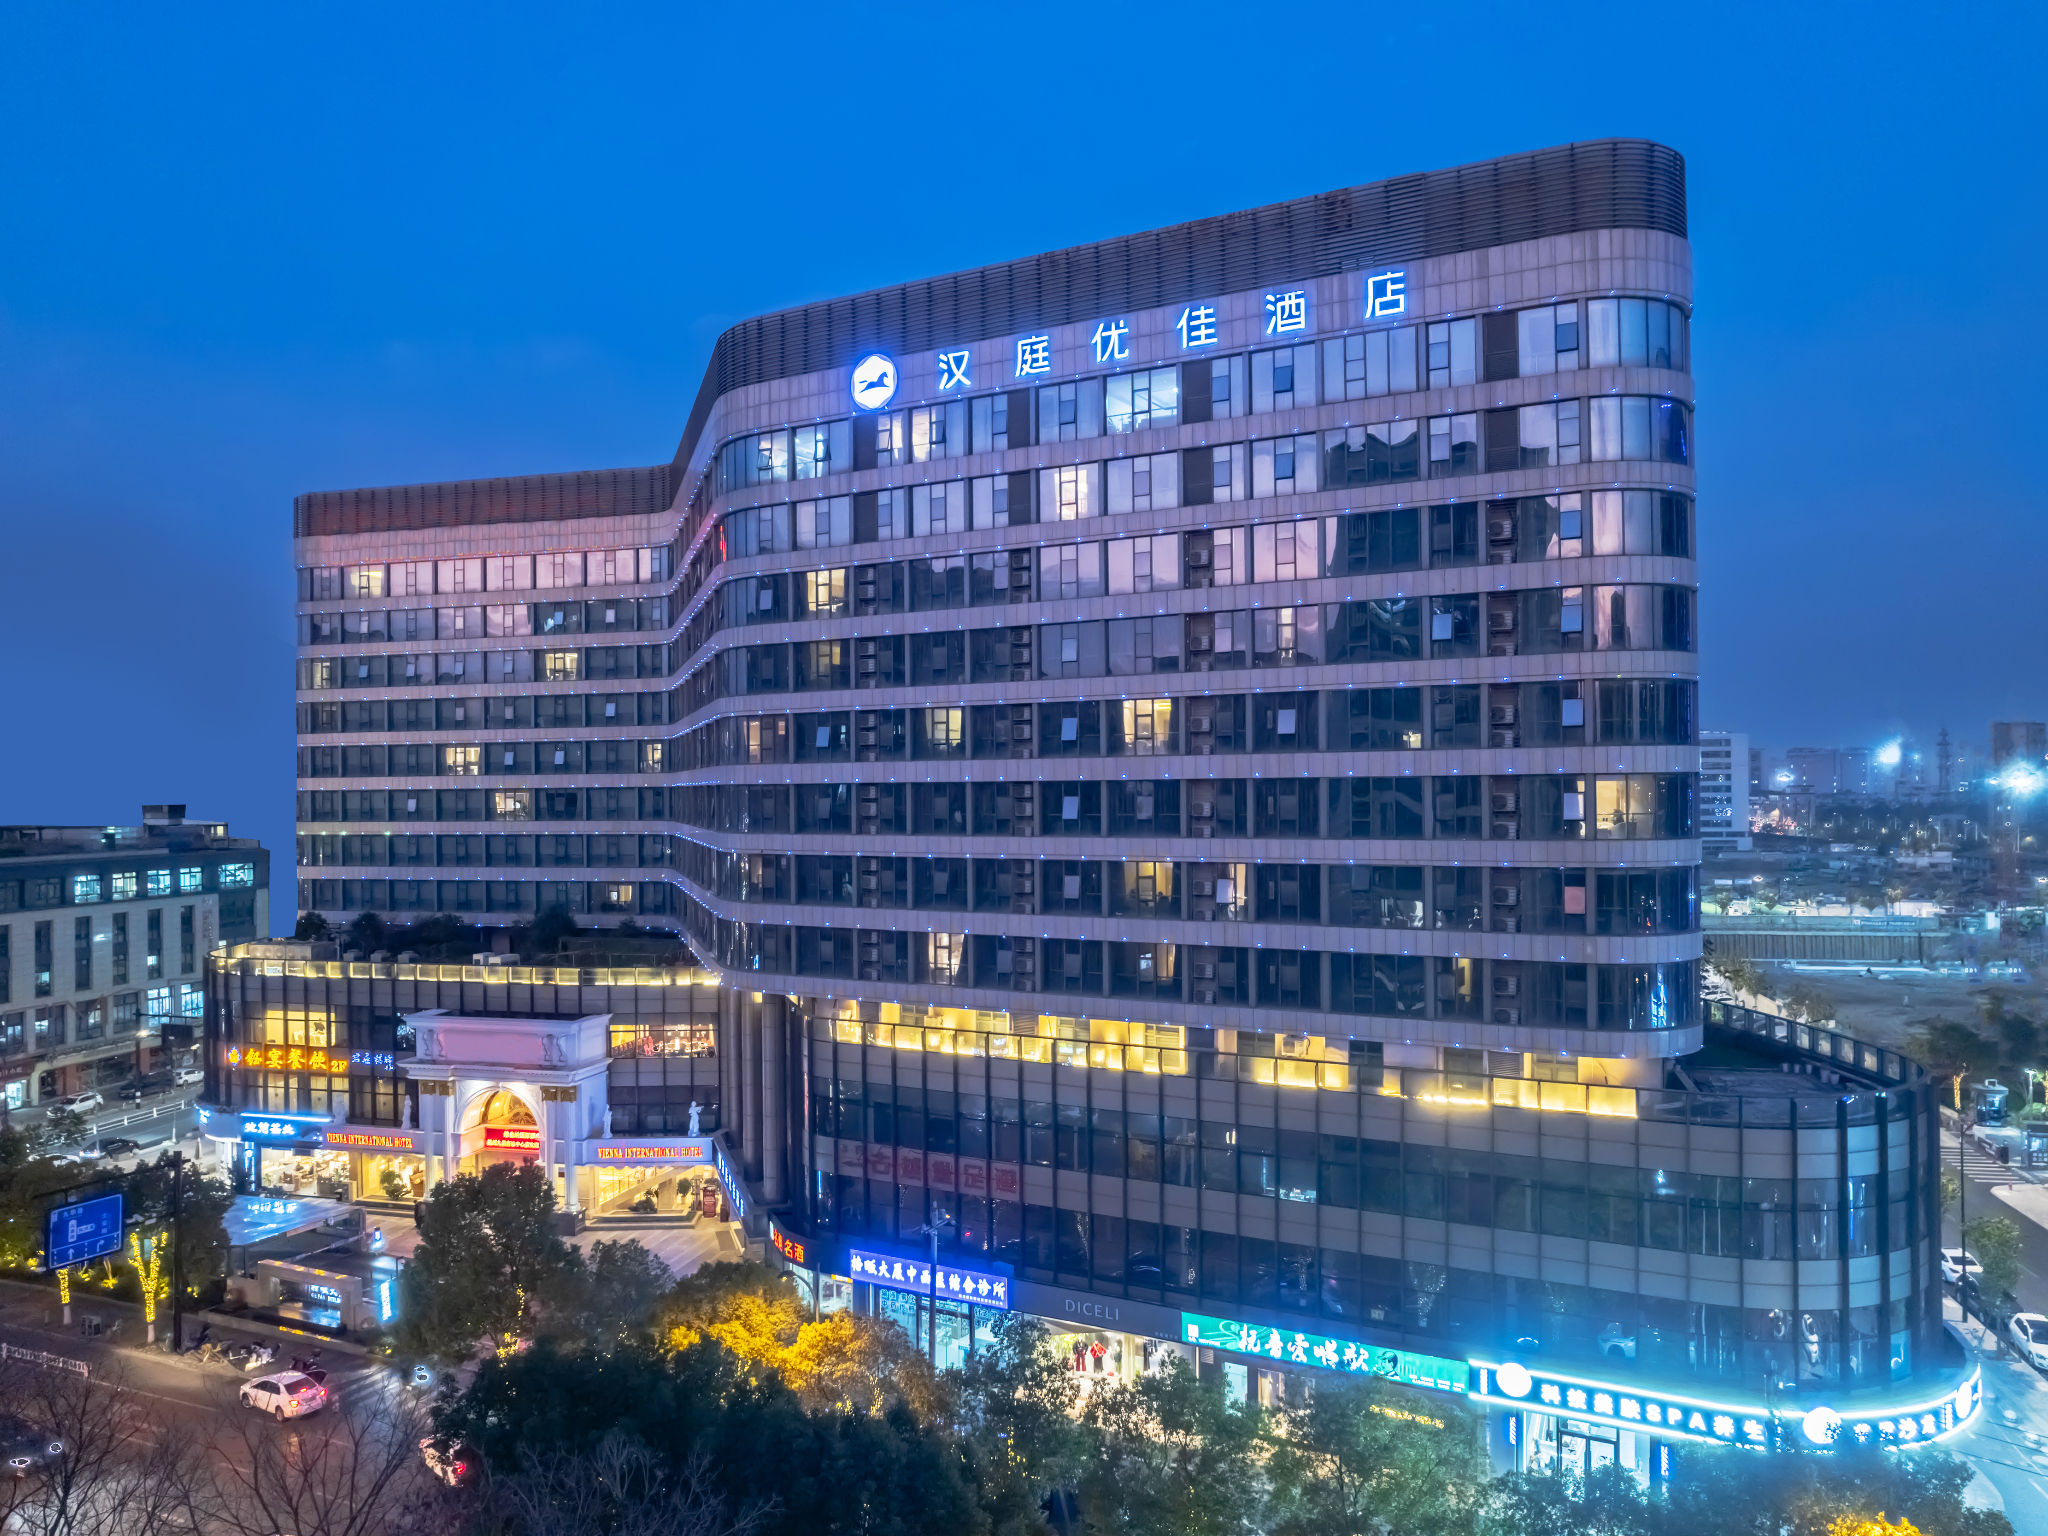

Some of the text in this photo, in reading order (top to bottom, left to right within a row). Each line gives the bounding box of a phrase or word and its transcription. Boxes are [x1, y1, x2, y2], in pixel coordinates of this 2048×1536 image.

[937, 271, 1407, 391] 汉庭优佳酒店
[331, 1060, 348, 1072] 2F
[326, 1132, 413, 1148] VIENNA INTERNATIONAL HOTEL
[597, 1146, 703, 1158] VIENNA INTERNATIONAL HOTEL
[1065, 1299, 1119, 1321] DICELI
